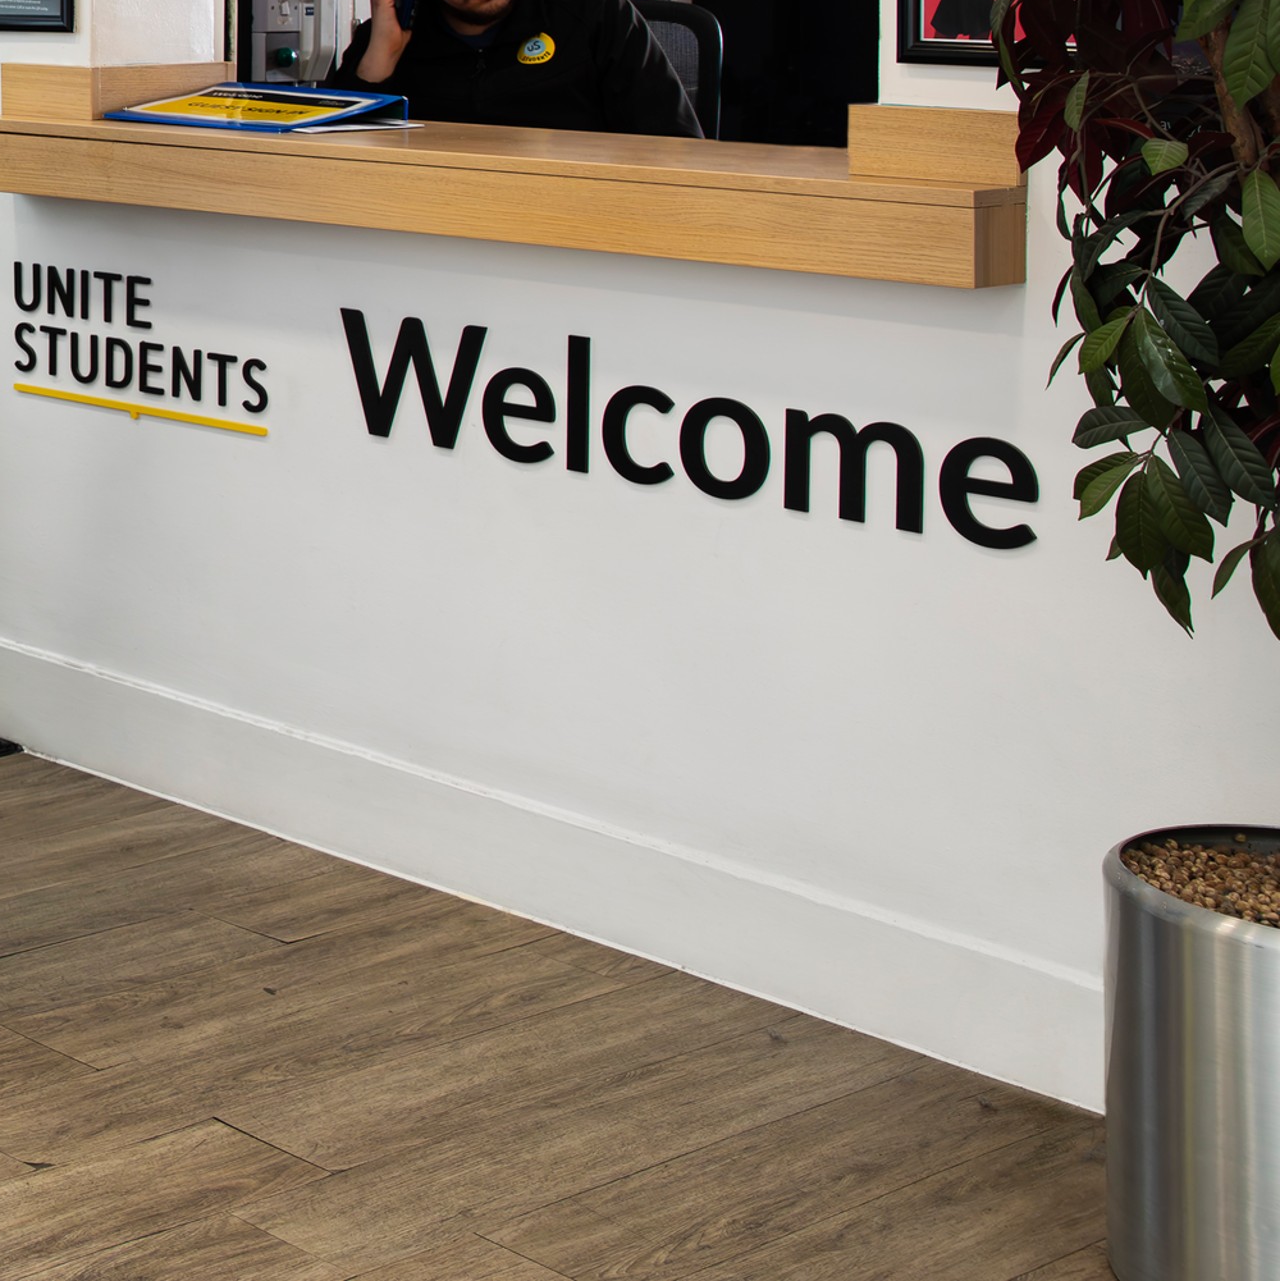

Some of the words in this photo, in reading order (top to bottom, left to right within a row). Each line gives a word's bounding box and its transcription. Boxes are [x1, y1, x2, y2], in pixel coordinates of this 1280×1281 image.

[14, 261, 153, 329] UNITE
[14, 322, 269, 413] STUDENTS
[340, 307, 1040, 551] Welcome
